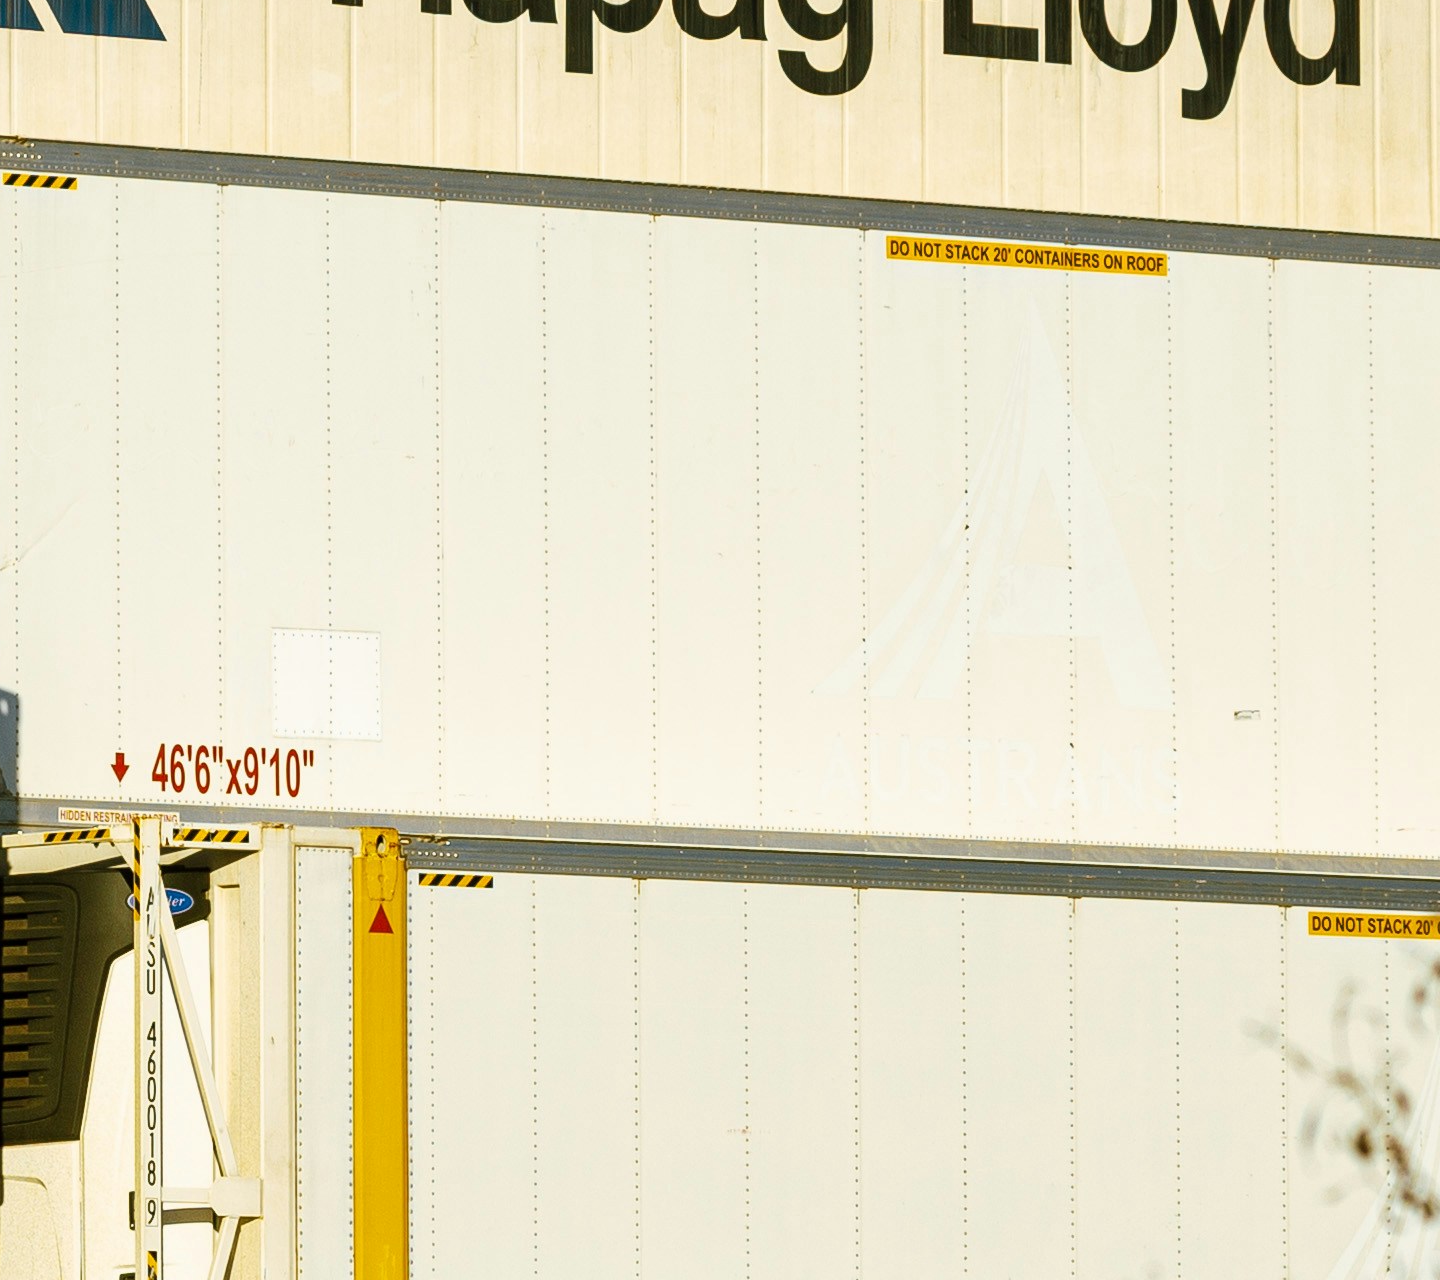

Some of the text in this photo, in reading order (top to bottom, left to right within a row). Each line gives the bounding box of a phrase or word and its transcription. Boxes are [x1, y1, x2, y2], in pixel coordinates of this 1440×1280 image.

[890, 240, 1164, 273] DO NOT STACK 20' CONTAINERS ON ROOF
[59, 810, 91, 822] HIDDEN
[1312, 915, 1332, 932] DO
[1335, 917, 1362, 933] NOT
[1367, 918, 1412, 935] STACK
[1415, 919, 1434, 936] 20'
[146, 1022, 157, 1187] 460018
[147, 1199, 156, 1225] 9
